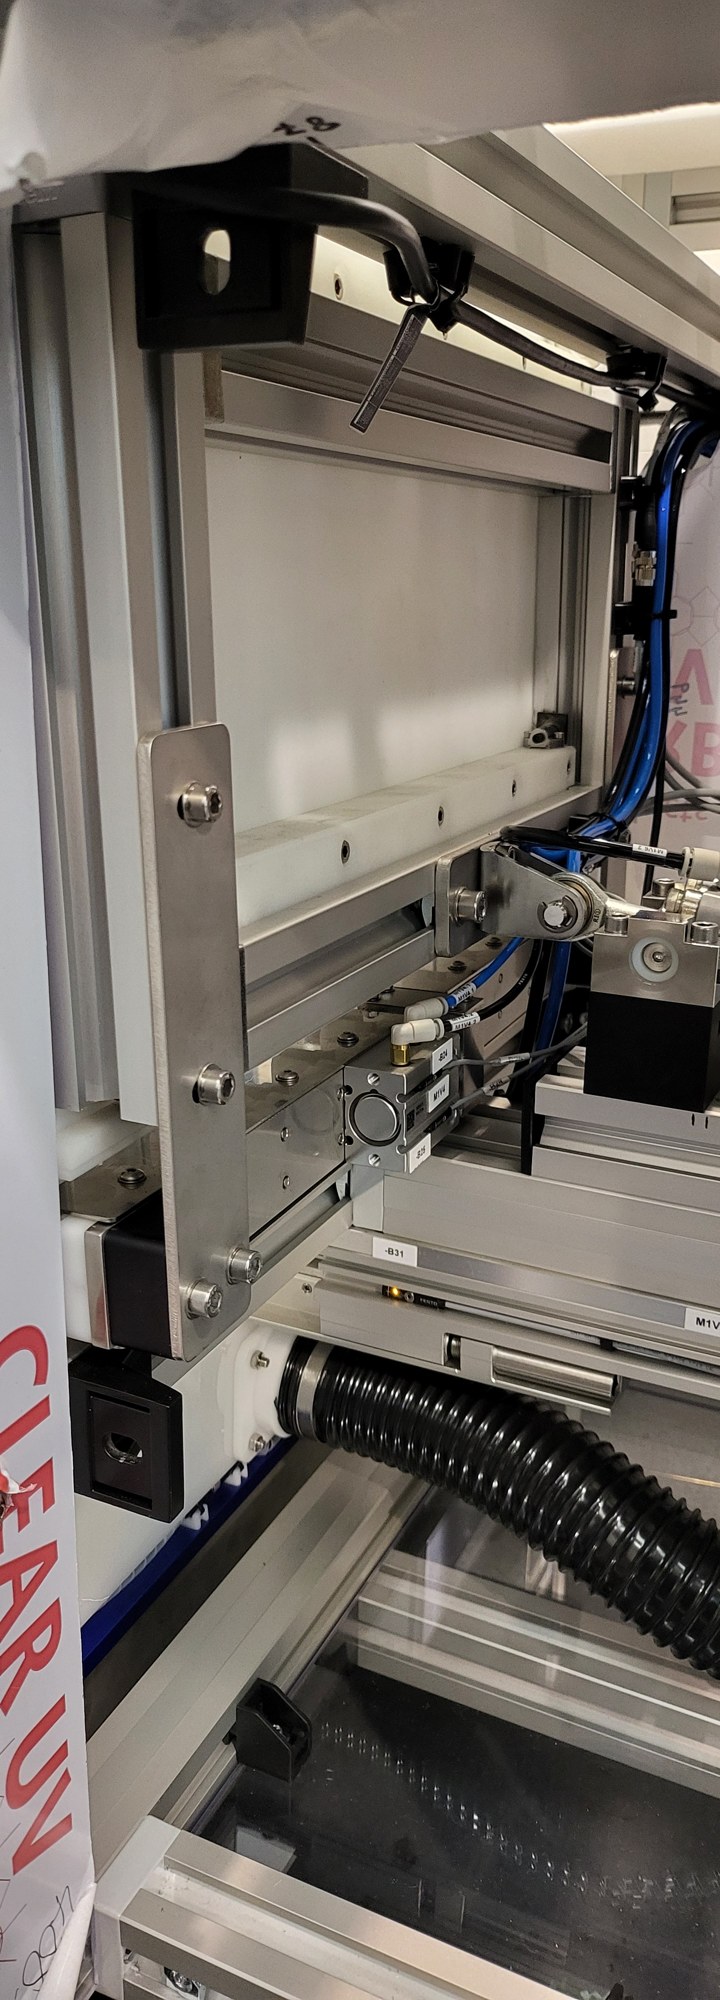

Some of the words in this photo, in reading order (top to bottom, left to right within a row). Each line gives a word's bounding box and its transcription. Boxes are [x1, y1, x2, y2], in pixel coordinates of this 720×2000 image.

[433, 1084, 446, 1102] M1V4
[384, 1247, 404, 1258] -B31
[5, 1693, 73, 1876] UV
